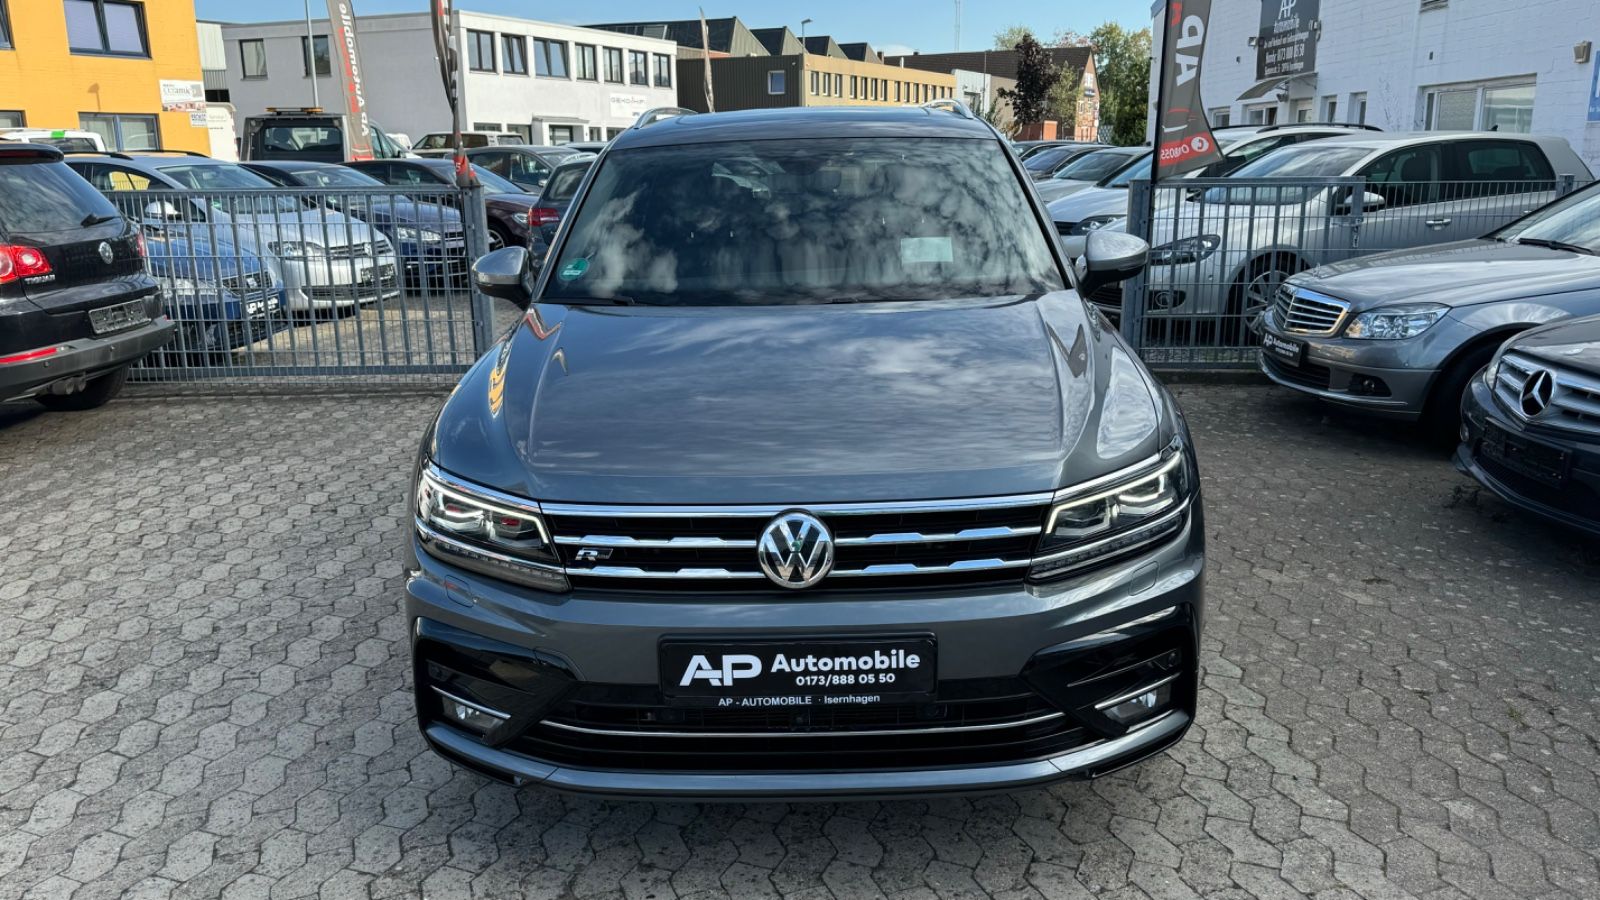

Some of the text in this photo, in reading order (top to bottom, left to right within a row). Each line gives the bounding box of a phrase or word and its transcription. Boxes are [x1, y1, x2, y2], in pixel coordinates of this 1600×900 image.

[680, 649, 921, 687] AP Automobile
[796, 672, 896, 687] 0173/888 05 50
[718, 697, 733, 707] AP
[741, 696, 812, 707] AUTOMOBILE
[823, 694, 881, 705] Isernhagen
